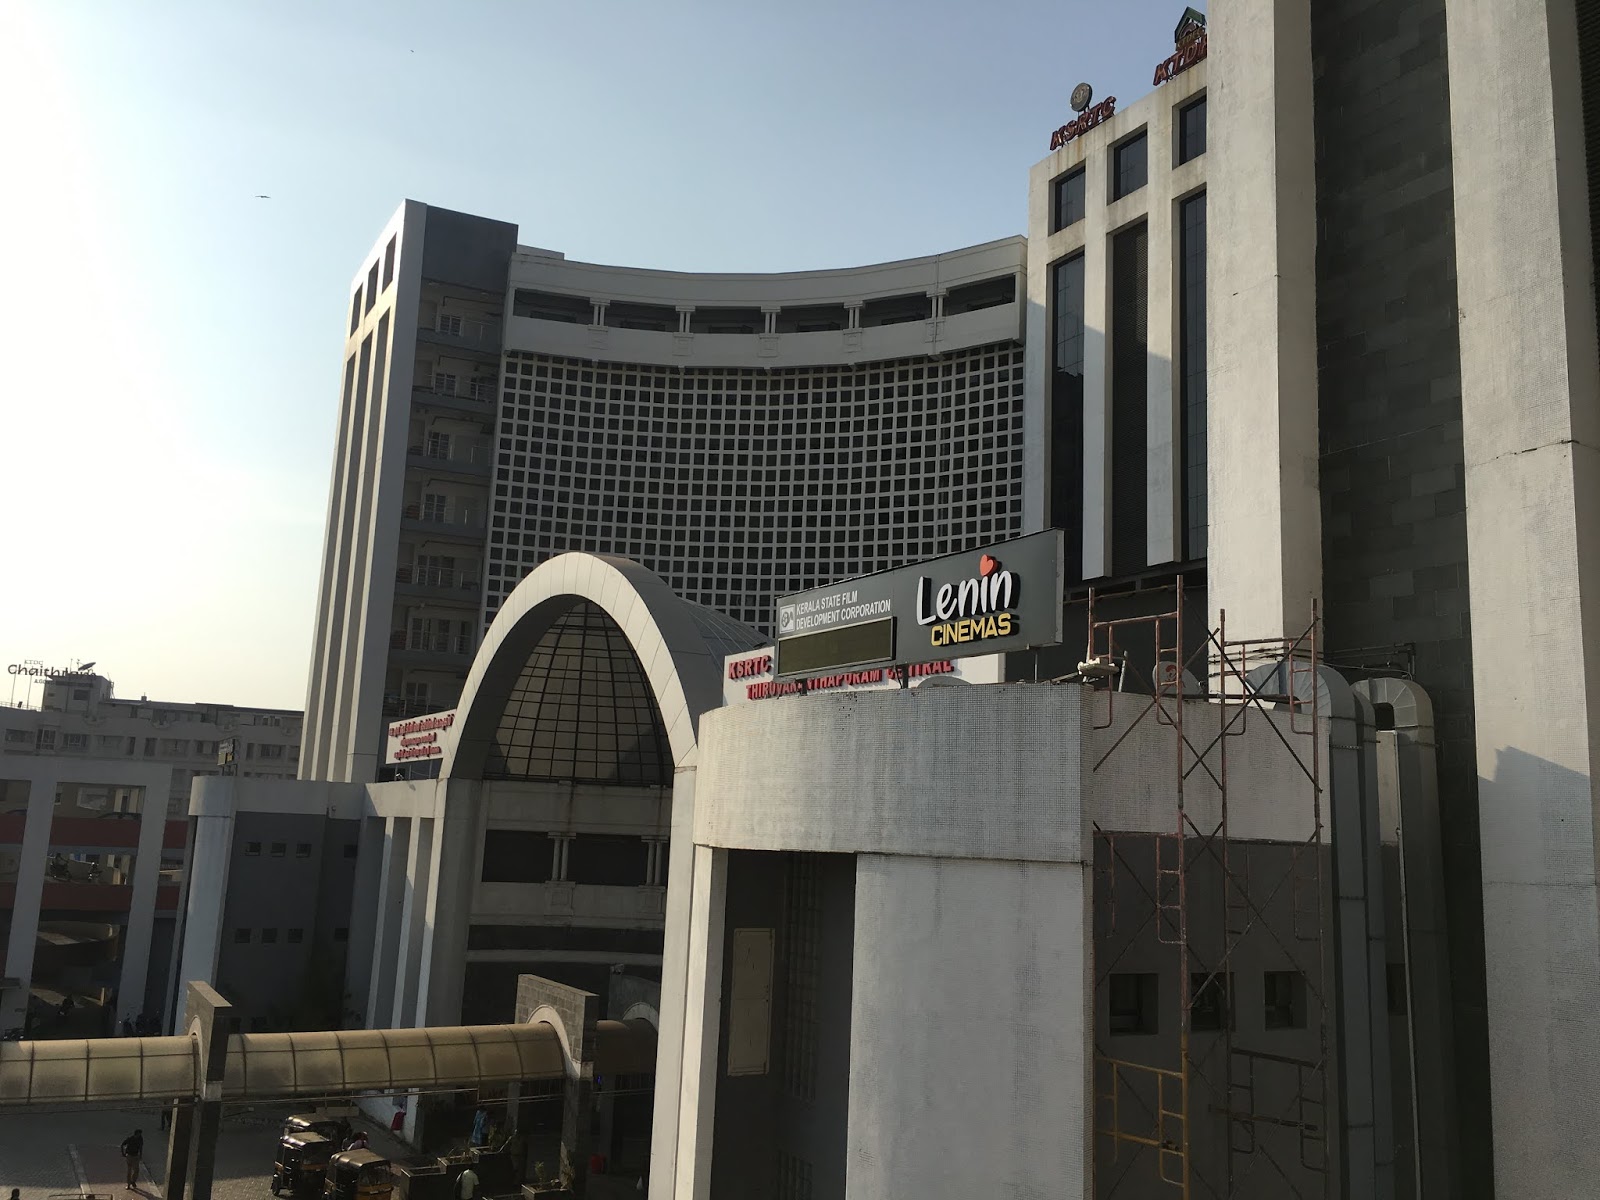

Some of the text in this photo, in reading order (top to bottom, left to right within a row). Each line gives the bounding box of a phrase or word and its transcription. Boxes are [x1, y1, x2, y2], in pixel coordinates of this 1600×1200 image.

[1050, 96, 1116, 150] KSRTC
[796, 590, 858, 616] KERALA STATE FILM
[917, 555, 1012, 626] Lenin
[796, 598, 891, 631] DEVELOPMENT CORPORATION
[931, 613, 1012, 646] CINEMAS
[728, 655, 772, 680] KSRTC
[746, 660, 954, 700] THIRUVANNTHAPURAM CTRAL
